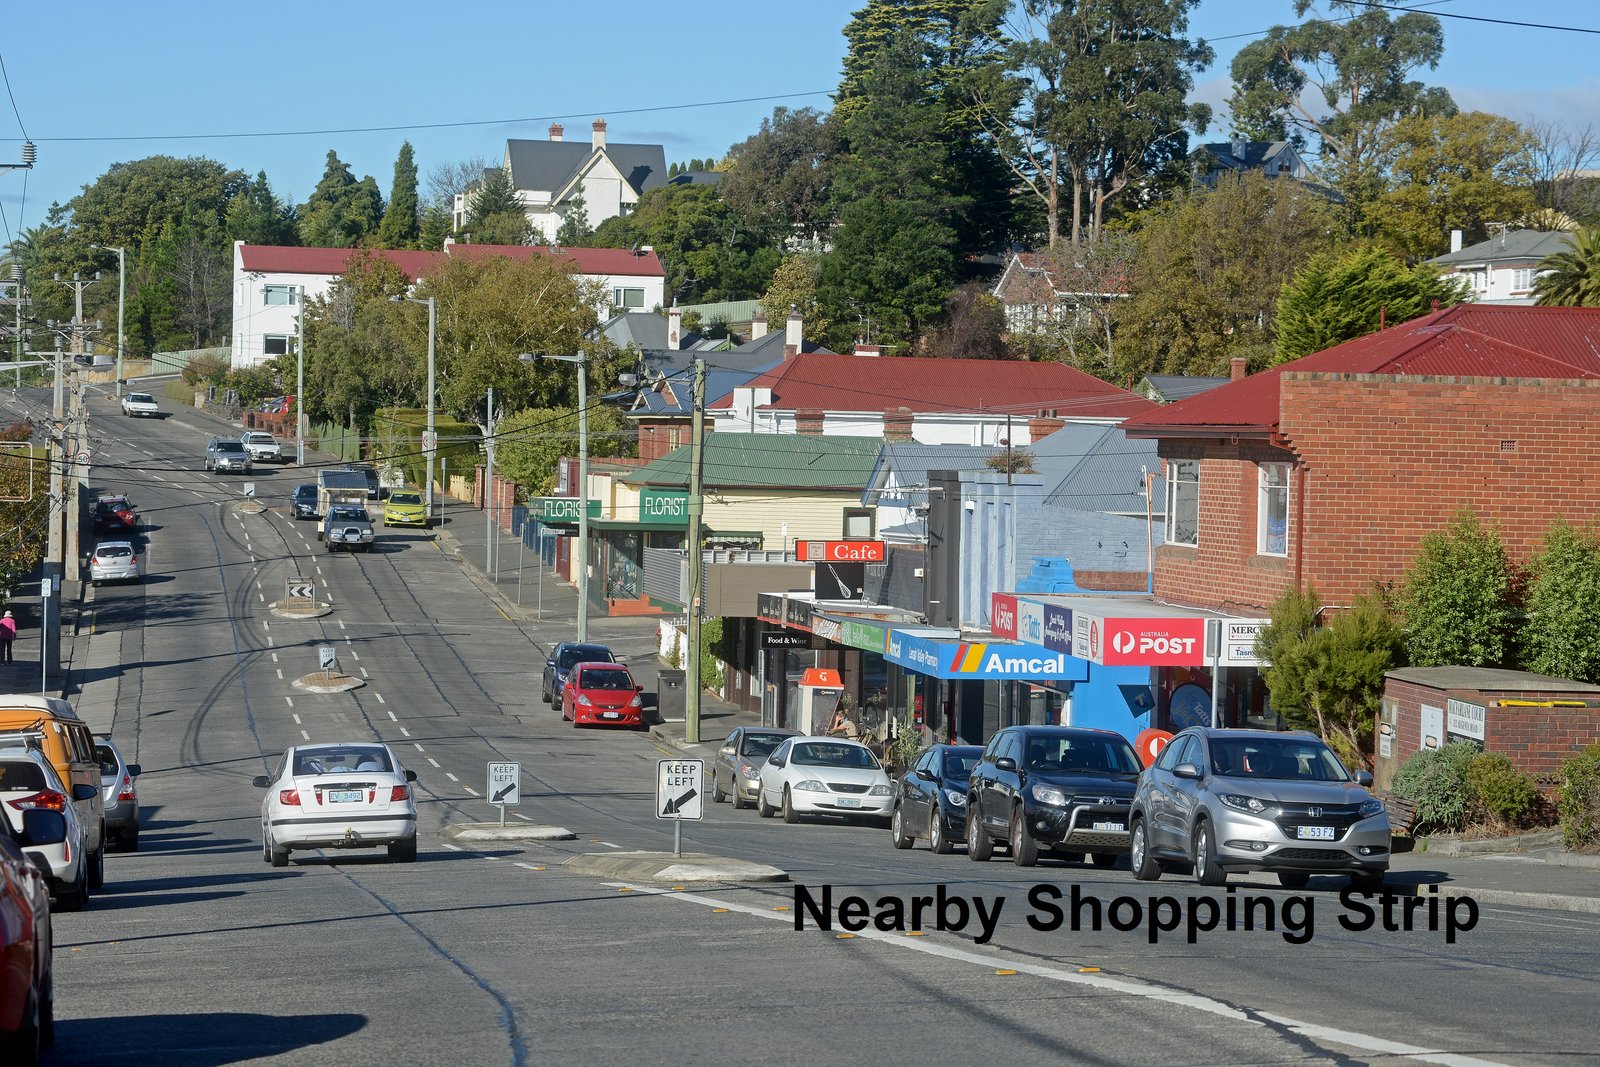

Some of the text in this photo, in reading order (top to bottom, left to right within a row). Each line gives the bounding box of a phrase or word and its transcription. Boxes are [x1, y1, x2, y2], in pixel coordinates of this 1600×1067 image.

[544, 501, 590, 517] FLORIS
[645, 497, 687, 515] FLORIST
[834, 545, 877, 559] Cafe
[1001, 611, 1013, 631] POST
[1231, 626, 1260, 634] MERC
[1139, 638, 1196, 654] POST
[985, 653, 1064, 673] Amcal
[667, 765, 697, 774] KEEP
[668, 777, 695, 786] LEFT
[1311, 827, 1321, 837] 53
[1323, 828, 1334, 837] FZ
